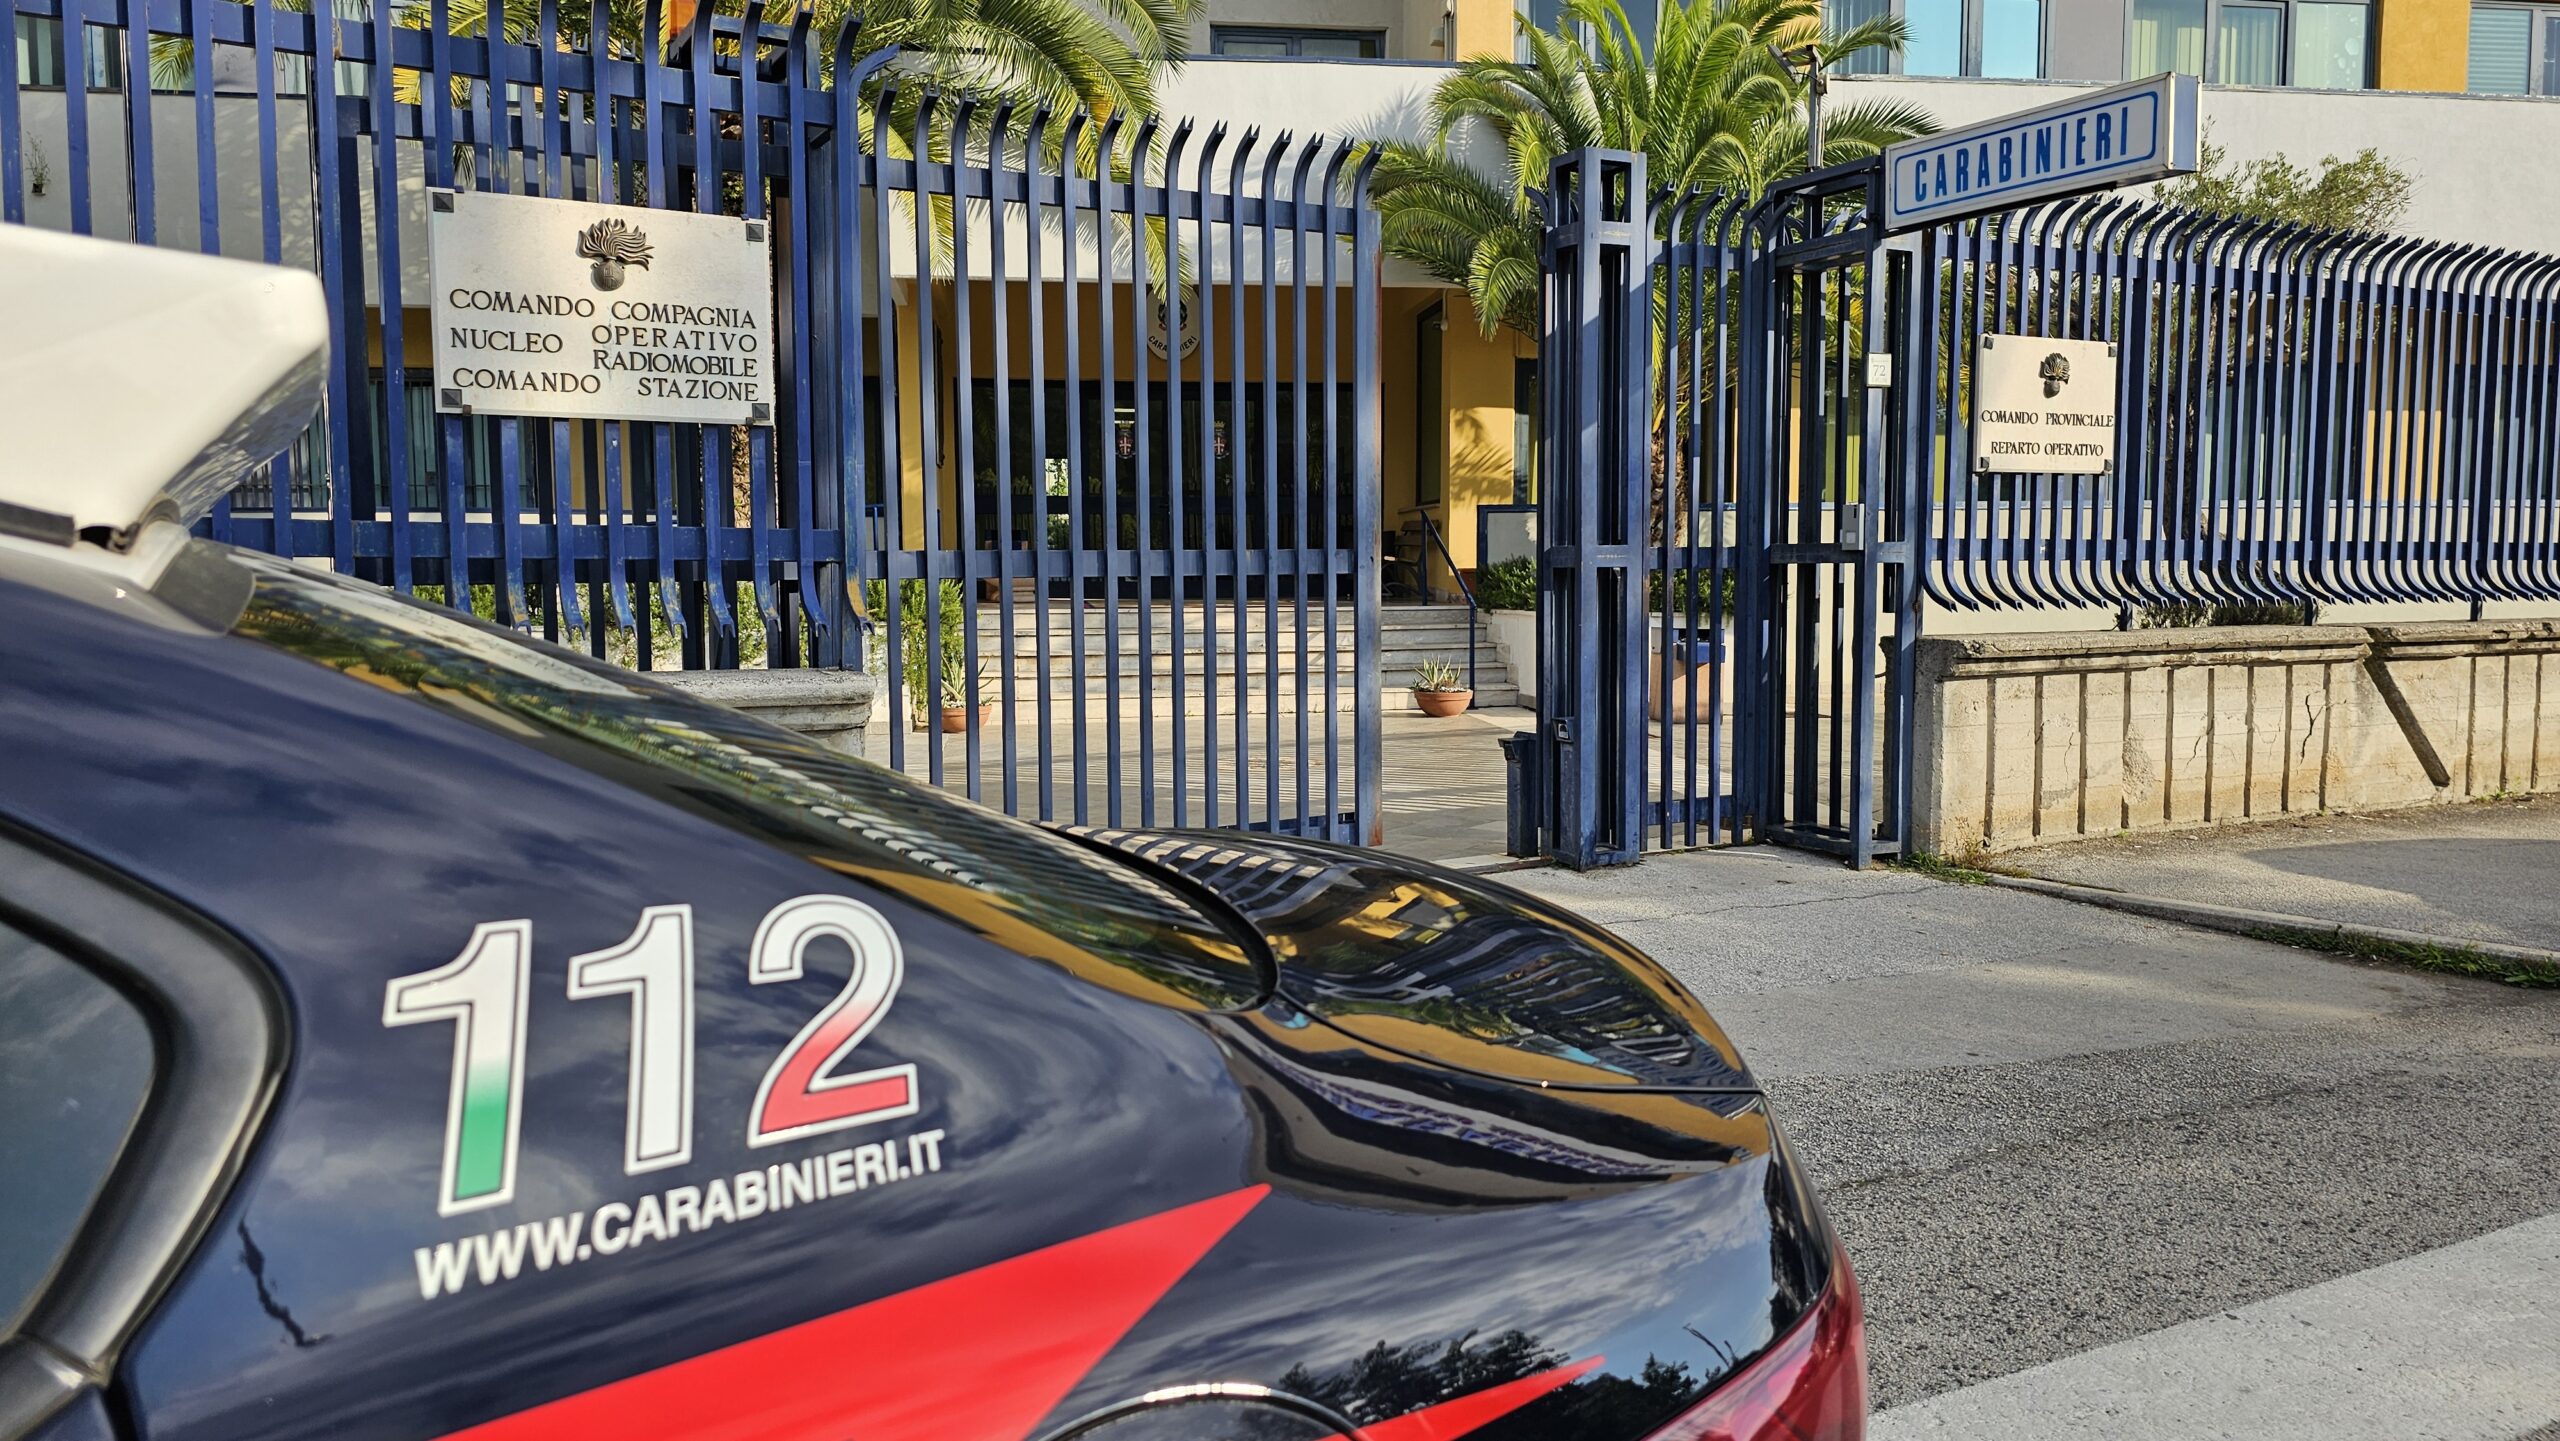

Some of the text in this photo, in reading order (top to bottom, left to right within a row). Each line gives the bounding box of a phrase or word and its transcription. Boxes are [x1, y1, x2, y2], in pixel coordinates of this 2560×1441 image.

[1914, 106, 2129, 202] CARABINIERI
[450, 288, 757, 329] COMANDO COMPAGNIA
[450, 325, 757, 353] NUCLEO OPERATIVO
[1148, 335, 1197, 352] CARAIERI
[593, 350, 758, 378] RADIOMOBILE
[1873, 364, 1886, 377] 72
[453, 368, 759, 402] COMANDO STAZIONE
[1981, 410, 2114, 428] COMANDO PROVINCIALE
[1991, 441, 2104, 456] REPARTO OPERATIVO
[382, 894, 919, 1217] 112
[414, 1129, 945, 1300] WWW.CARABINIERI.IT
